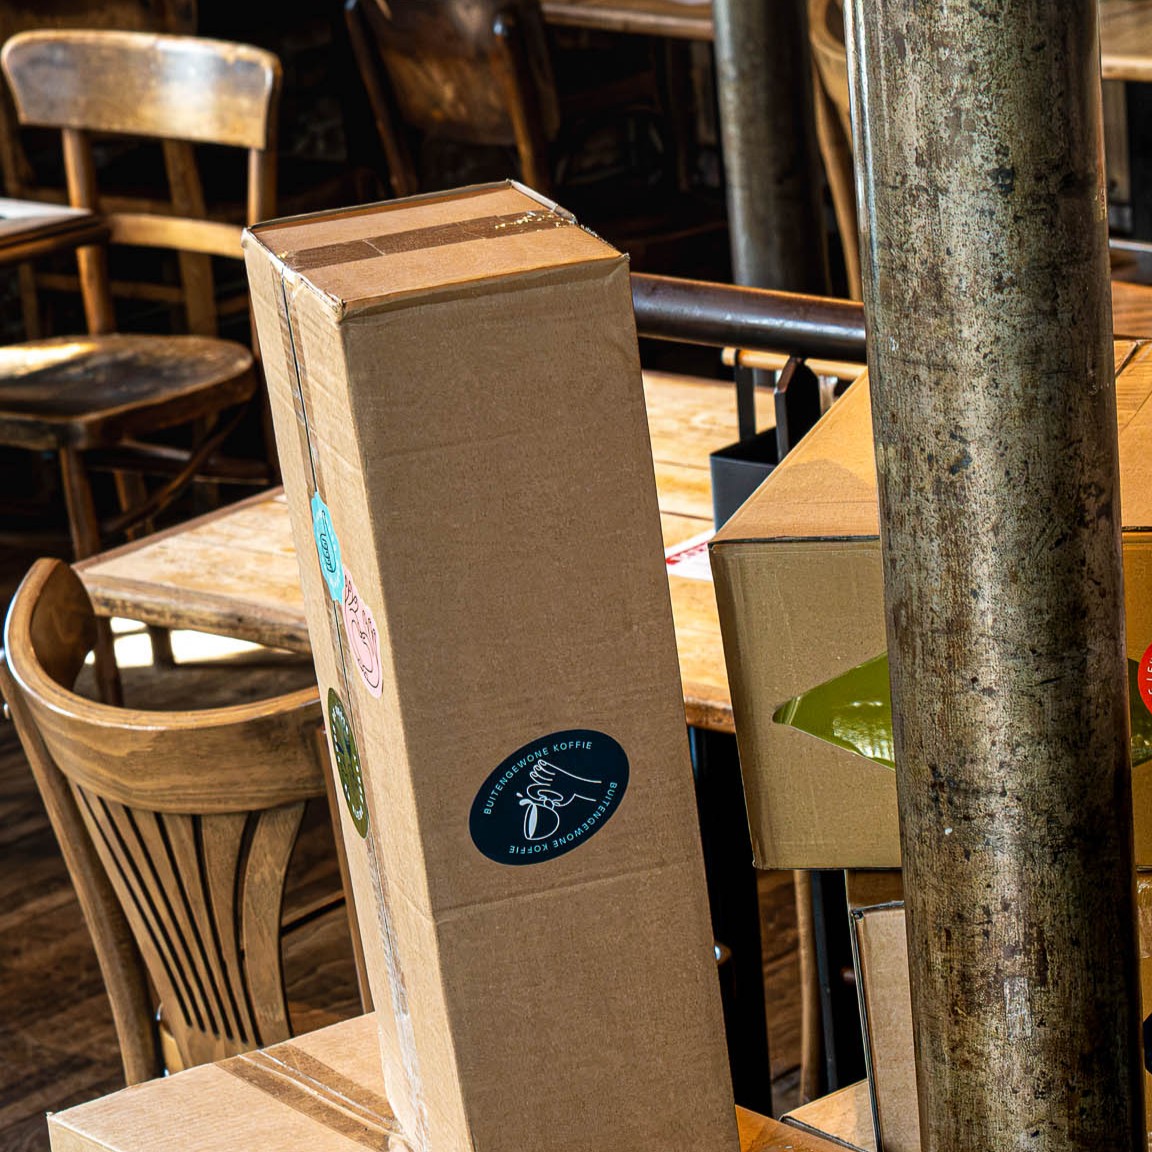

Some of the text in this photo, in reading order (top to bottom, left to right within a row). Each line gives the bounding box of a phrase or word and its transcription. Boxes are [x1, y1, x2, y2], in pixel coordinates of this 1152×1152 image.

[483, 740, 593, 815] BUITENGEWONE KOFFIE
[508, 781, 618, 854] BUITENGEWONE KOFFIE
